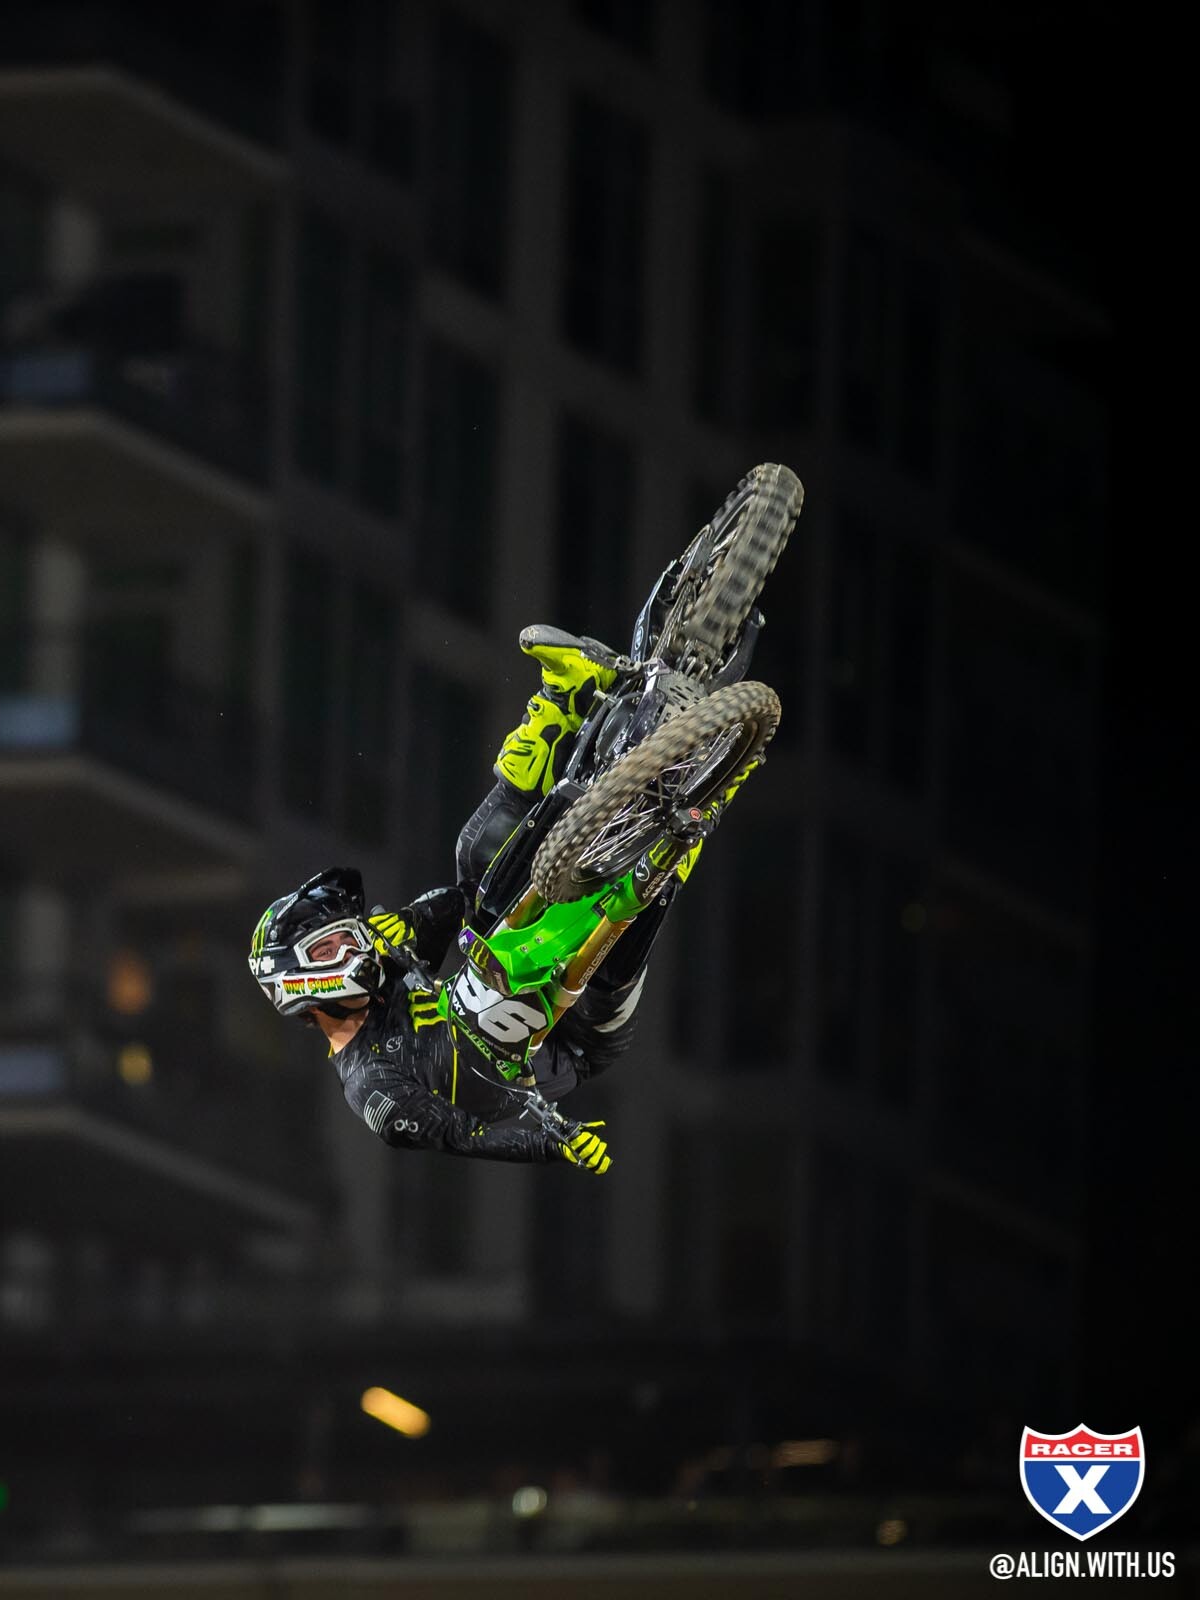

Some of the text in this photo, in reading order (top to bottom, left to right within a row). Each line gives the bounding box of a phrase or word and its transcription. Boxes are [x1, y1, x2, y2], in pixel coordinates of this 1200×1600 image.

[282, 974, 346, 995] DIRT SHARK
[577, 964, 594, 986] PRO
